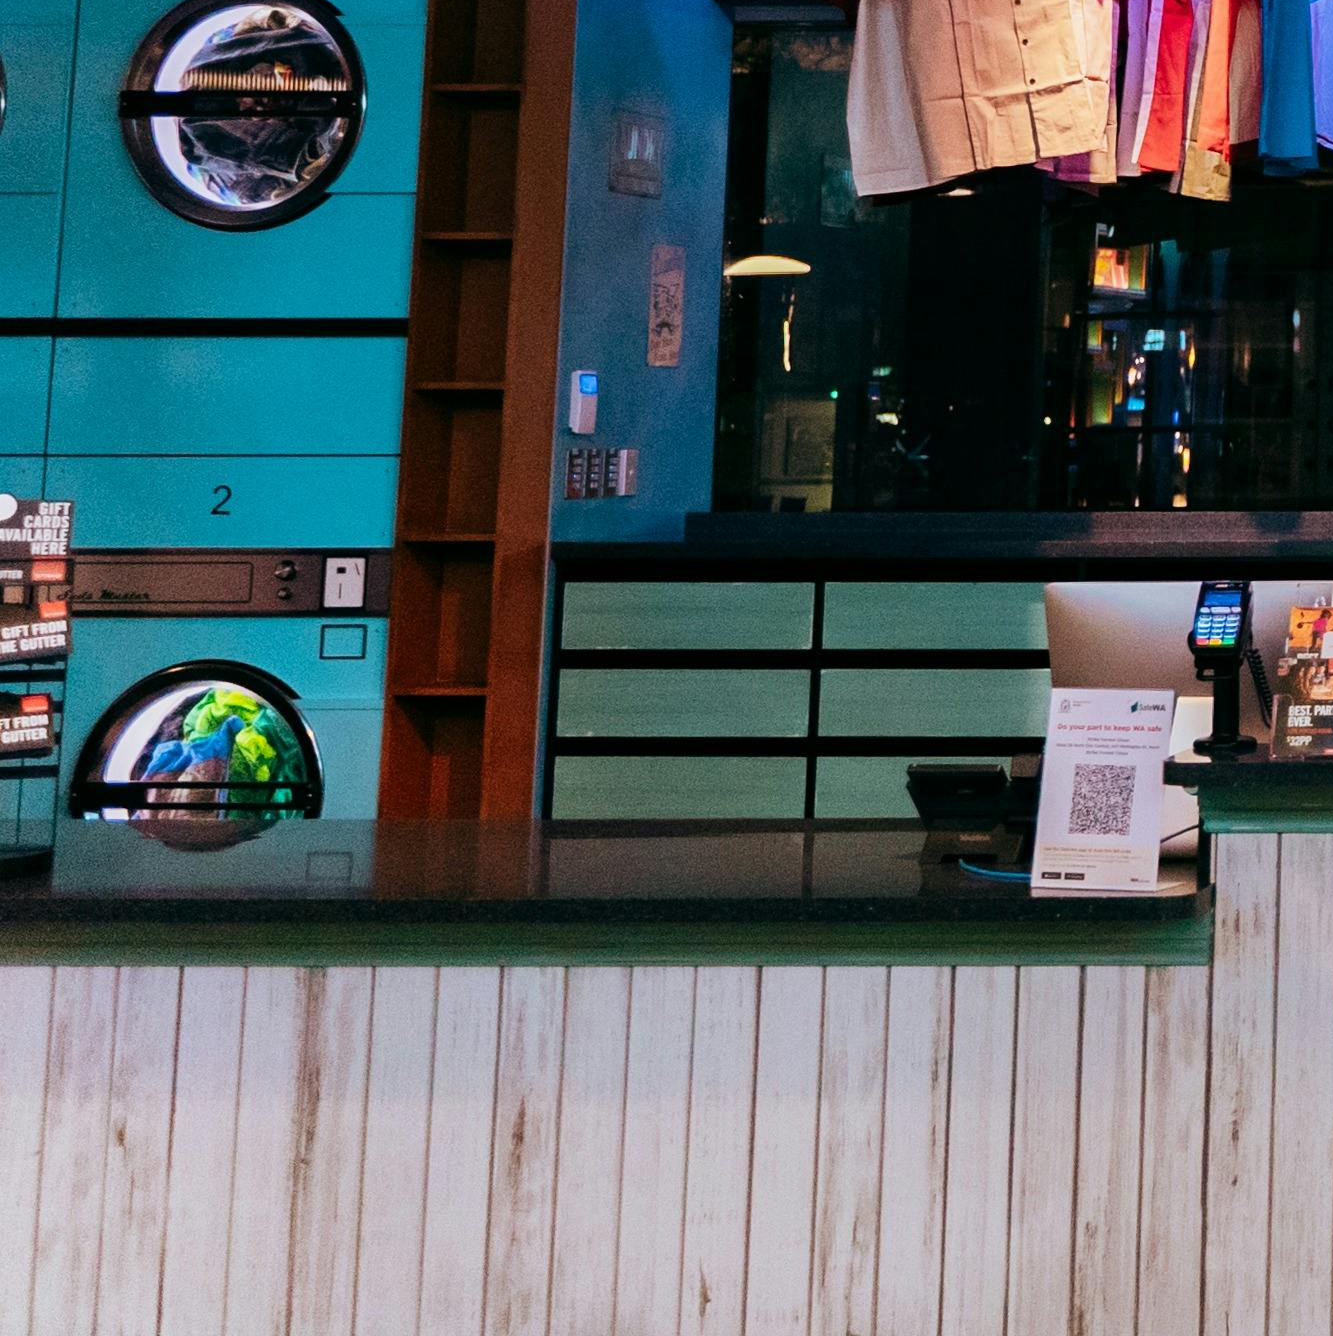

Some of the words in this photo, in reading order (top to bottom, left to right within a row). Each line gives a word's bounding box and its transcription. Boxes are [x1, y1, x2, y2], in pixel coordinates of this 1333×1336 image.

[210, 485, 232, 515] 2
[39, 502, 71, 515] GIFT
[23, 515, 70, 528] CARDS
[31, 542, 67, 555] HERE
[2, 625, 29, 639] GIFT
[31, 620, 67, 635] FROM
[20, 634, 66, 651] GUTTER
[1288, 705, 1313, 716] BEST.
[13, 714, 49, 729] FROM
[1287, 716, 1313, 727] EVER.
[1, 728, 48, 744] GUTTER
